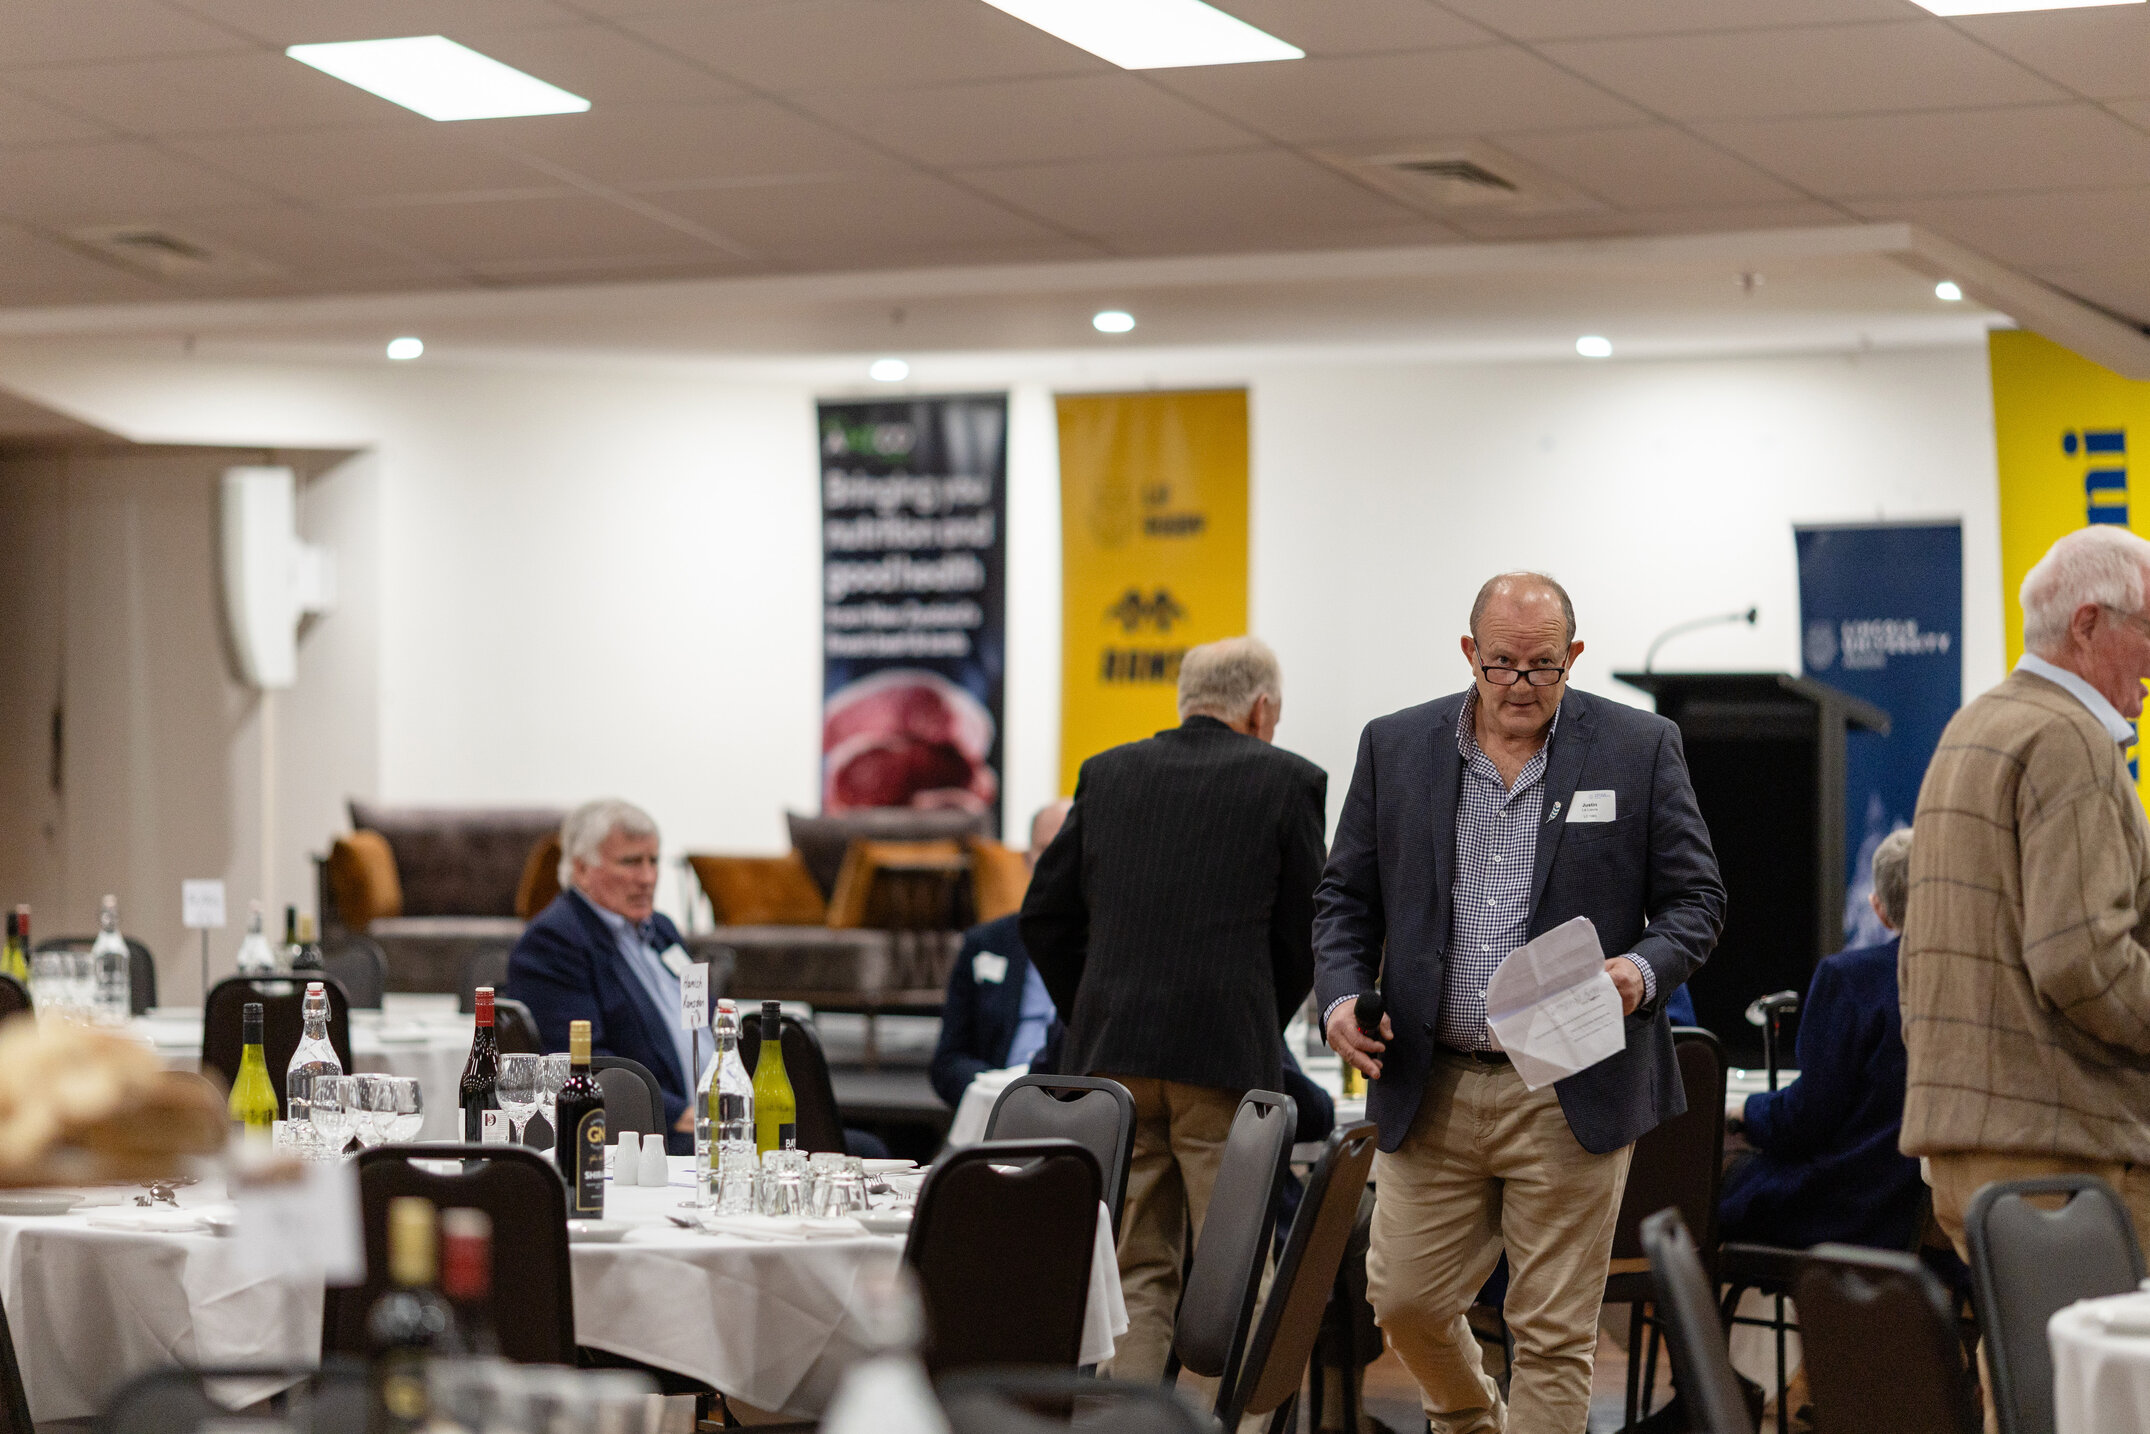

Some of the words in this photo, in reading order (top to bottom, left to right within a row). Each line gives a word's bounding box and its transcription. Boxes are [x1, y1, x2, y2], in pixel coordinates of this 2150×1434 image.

[826, 470, 938, 514] Bringing
[826, 553, 896, 601] good
[900, 553, 983, 591] health
